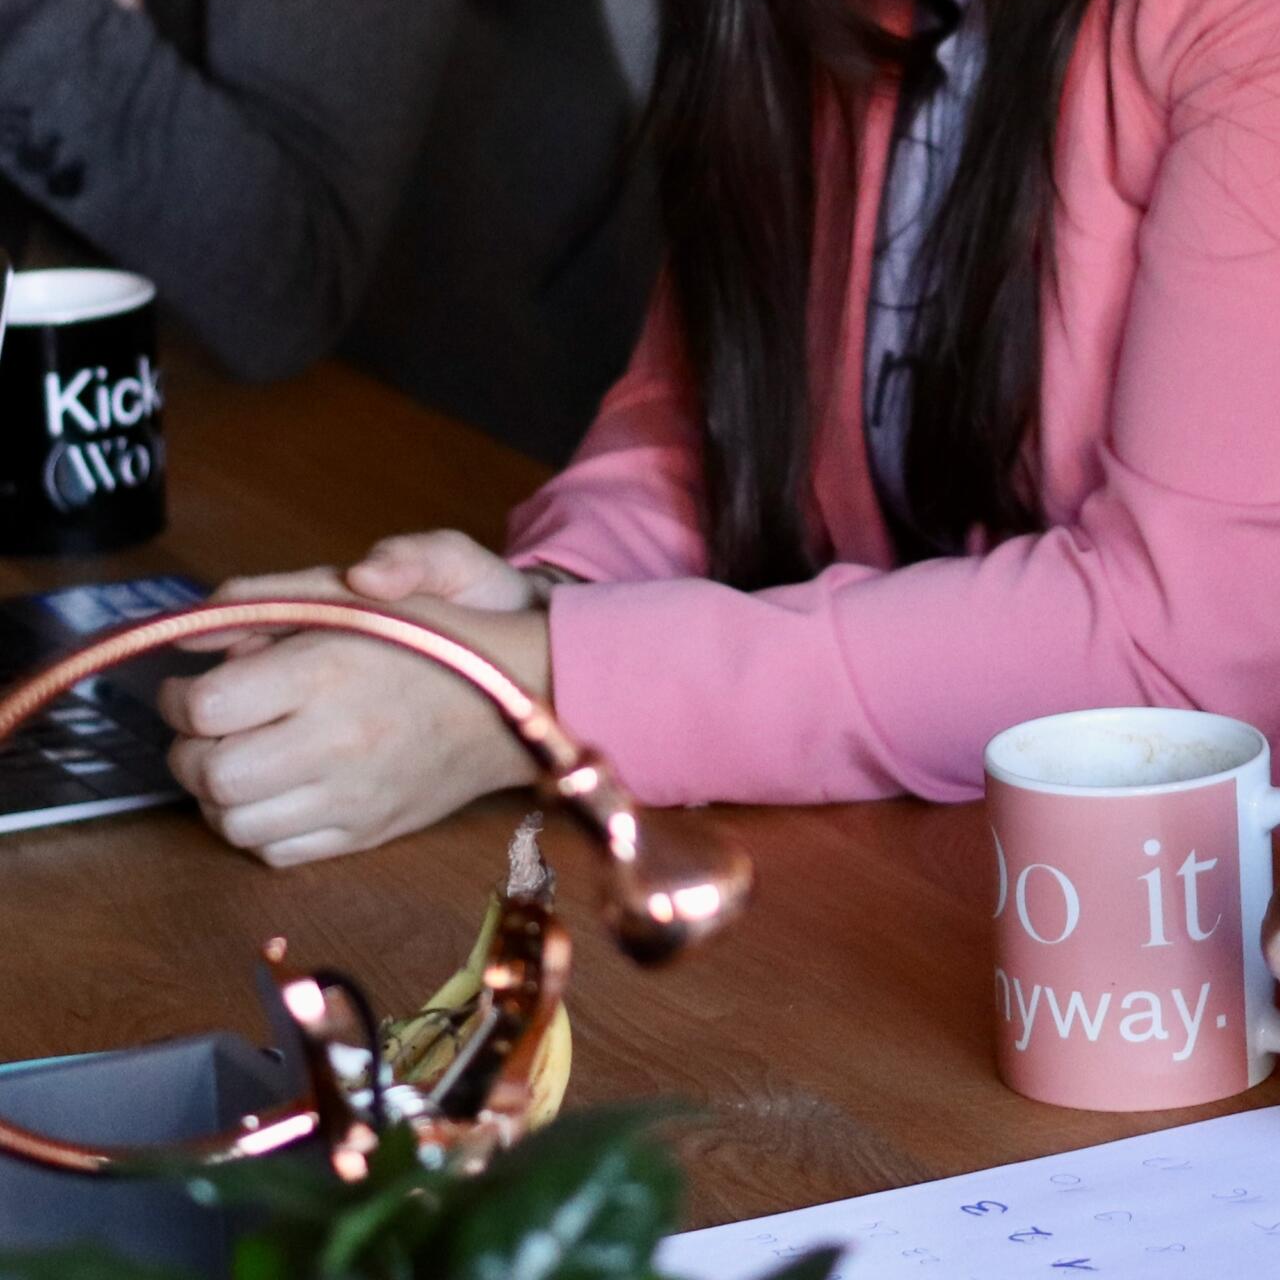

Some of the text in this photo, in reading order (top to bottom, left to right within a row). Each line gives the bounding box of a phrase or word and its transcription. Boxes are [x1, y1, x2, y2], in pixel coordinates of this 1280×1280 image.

[46, 355, 161, 435] Kick
[1137, 838, 1222, 948] it
[960, 1199, 1009, 1217] 3
[1008, 1226, 1053, 1243] 2
